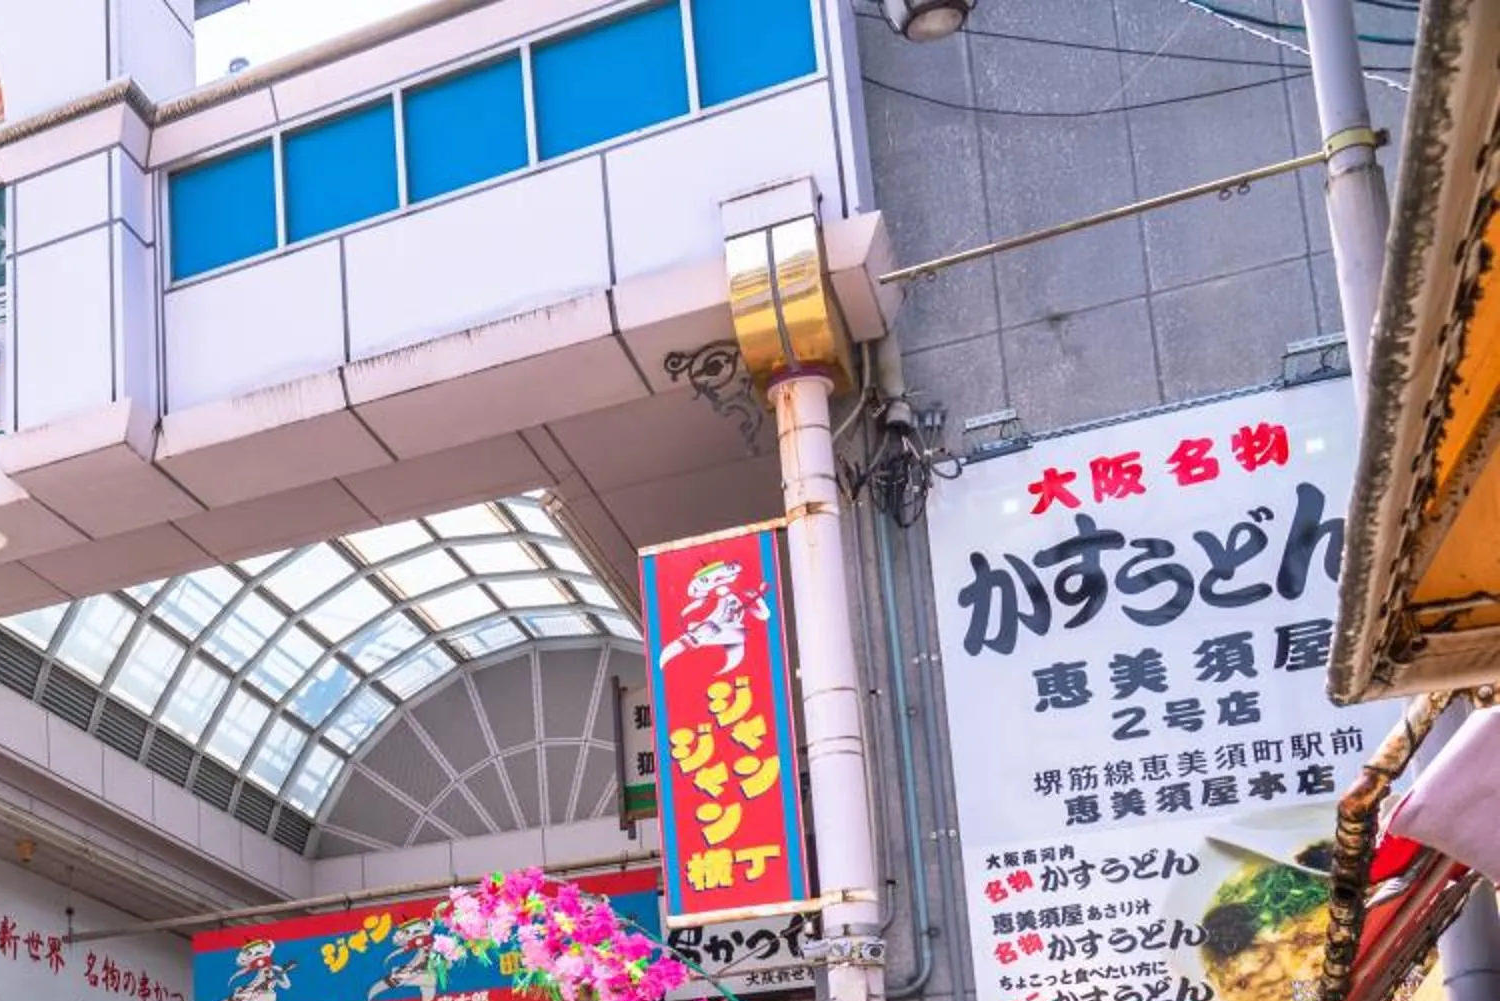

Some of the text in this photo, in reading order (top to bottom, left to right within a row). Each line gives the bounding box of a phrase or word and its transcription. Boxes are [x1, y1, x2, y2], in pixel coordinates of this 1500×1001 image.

[1028, 422, 1290, 515] 大阪名物
[958, 482, 1346, 657] かすうどん
[1032, 618, 1335, 713] 恵美須屋
[1111, 690, 1261, 741] 2号店
[1034, 725, 1365, 797] 堺筋線恵美須町駅前
[1065, 764, 1336, 826] 恵美須屋本店
[686, 844, 781, 892] 横丁
